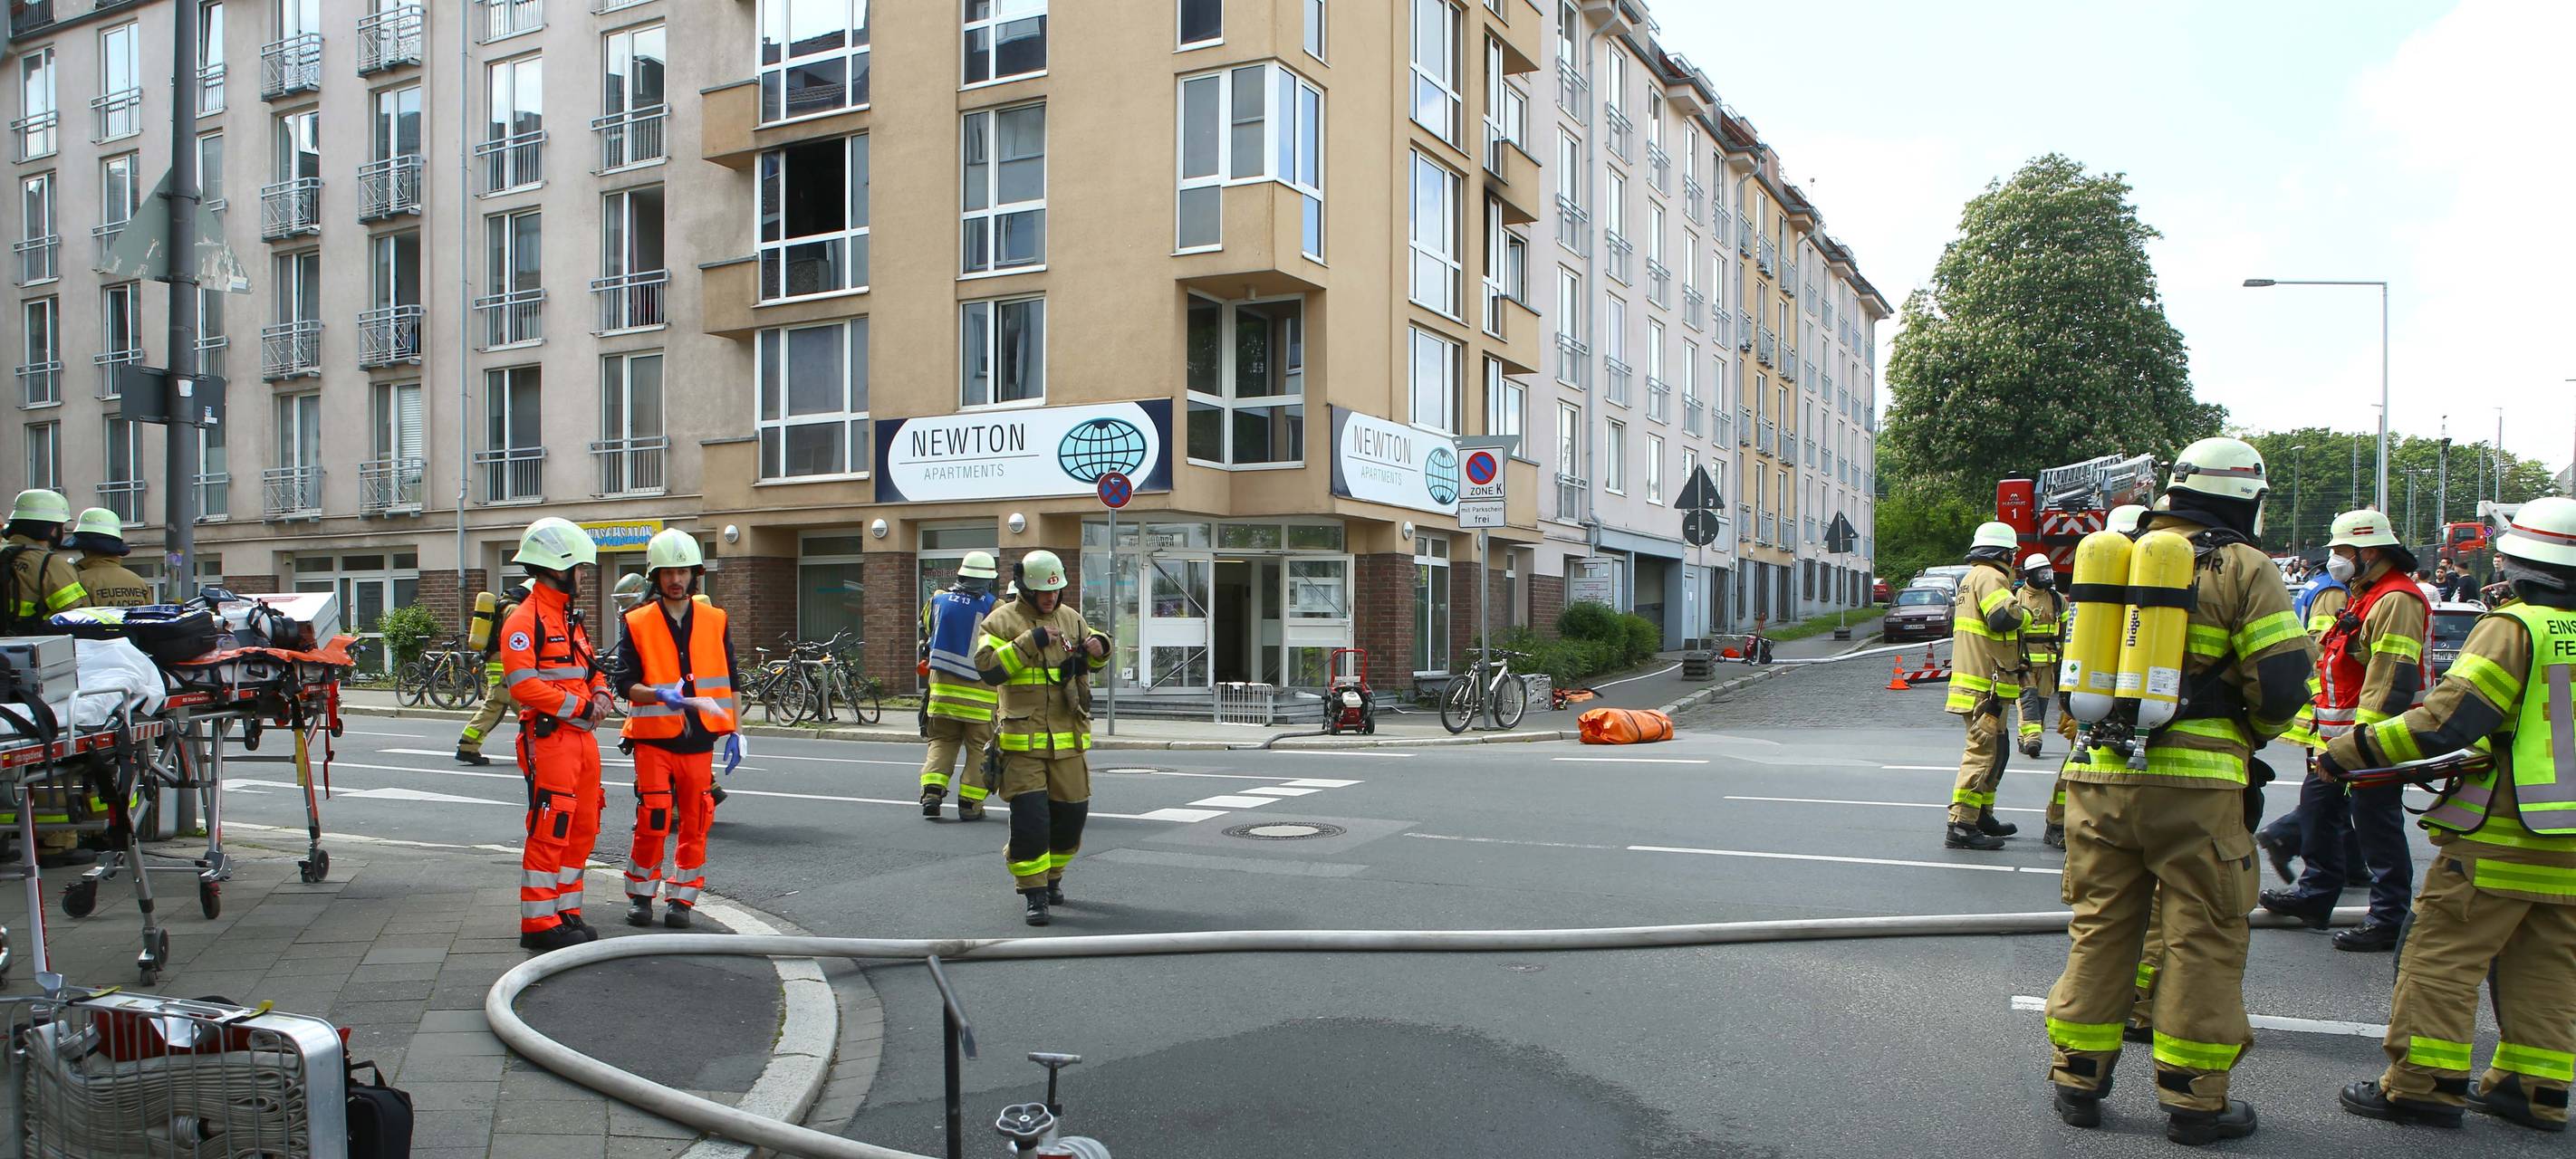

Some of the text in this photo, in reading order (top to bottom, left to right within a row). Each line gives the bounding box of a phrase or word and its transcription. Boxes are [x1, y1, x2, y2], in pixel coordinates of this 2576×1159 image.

[912, 423, 1024, 457] NEWTON
[1354, 425, 1410, 465] NEWTON
[924, 463, 1004, 480] APARTMENTS
[1361, 465, 1402, 486] APARTMENTS
[1470, 483, 1503, 495] ZONE K
[1475, 515, 1490, 523] frei
[2011, 507, 2018, 520] 1
[948, 595, 960, 603] LZ
[961, 597, 971, 606] 13
[2126, 609, 2140, 647] Dräger
